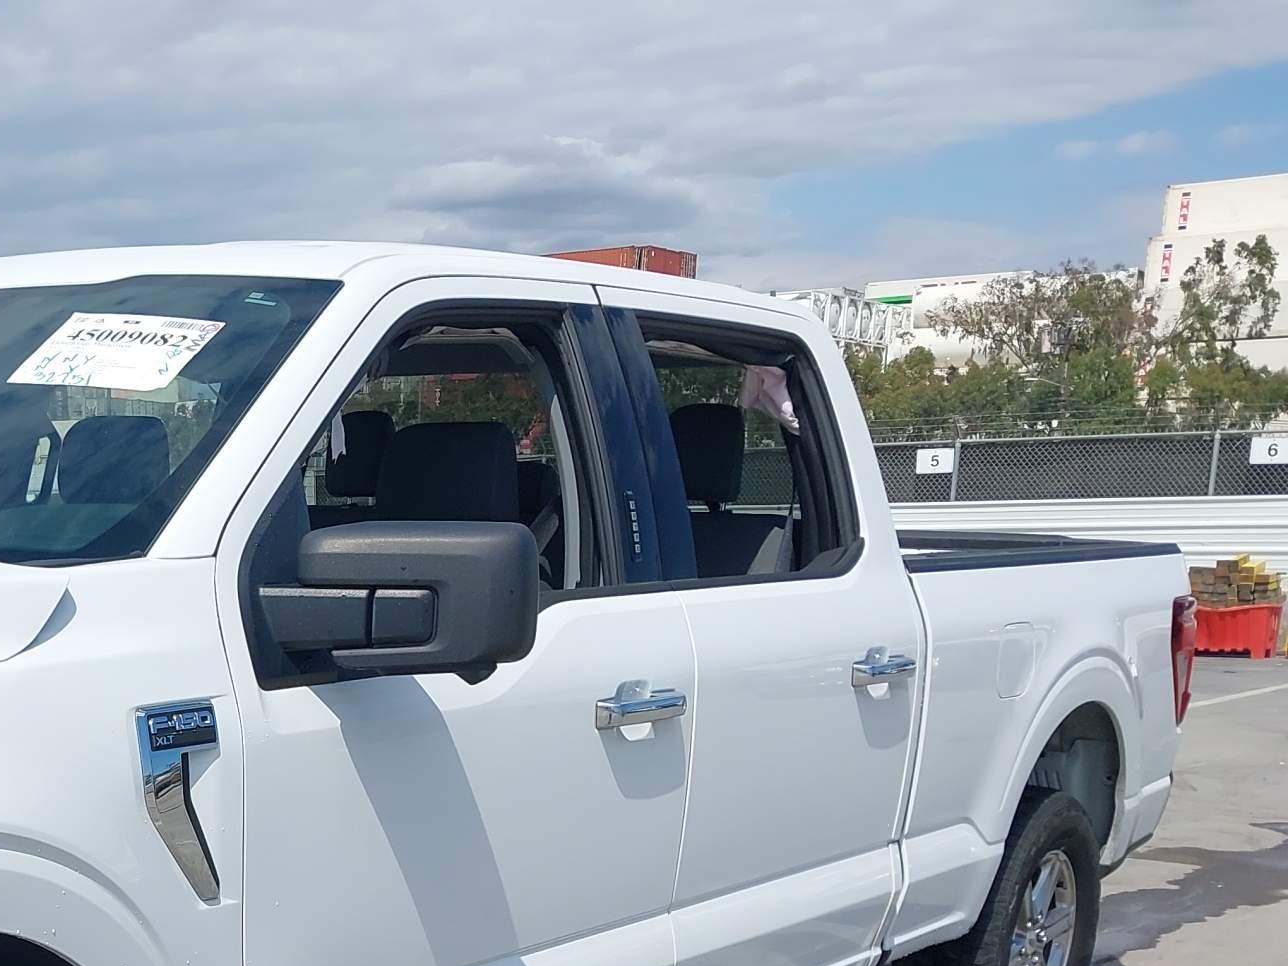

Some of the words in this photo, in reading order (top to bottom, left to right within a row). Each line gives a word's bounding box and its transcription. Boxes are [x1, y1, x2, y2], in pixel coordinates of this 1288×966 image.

[66, 328, 188, 348] 45009082
[1267, 443, 1279, 457] 6
[930, 454, 940, 467] 5
[148, 710, 216, 734] F-150
[156, 735, 175, 746] XLT
